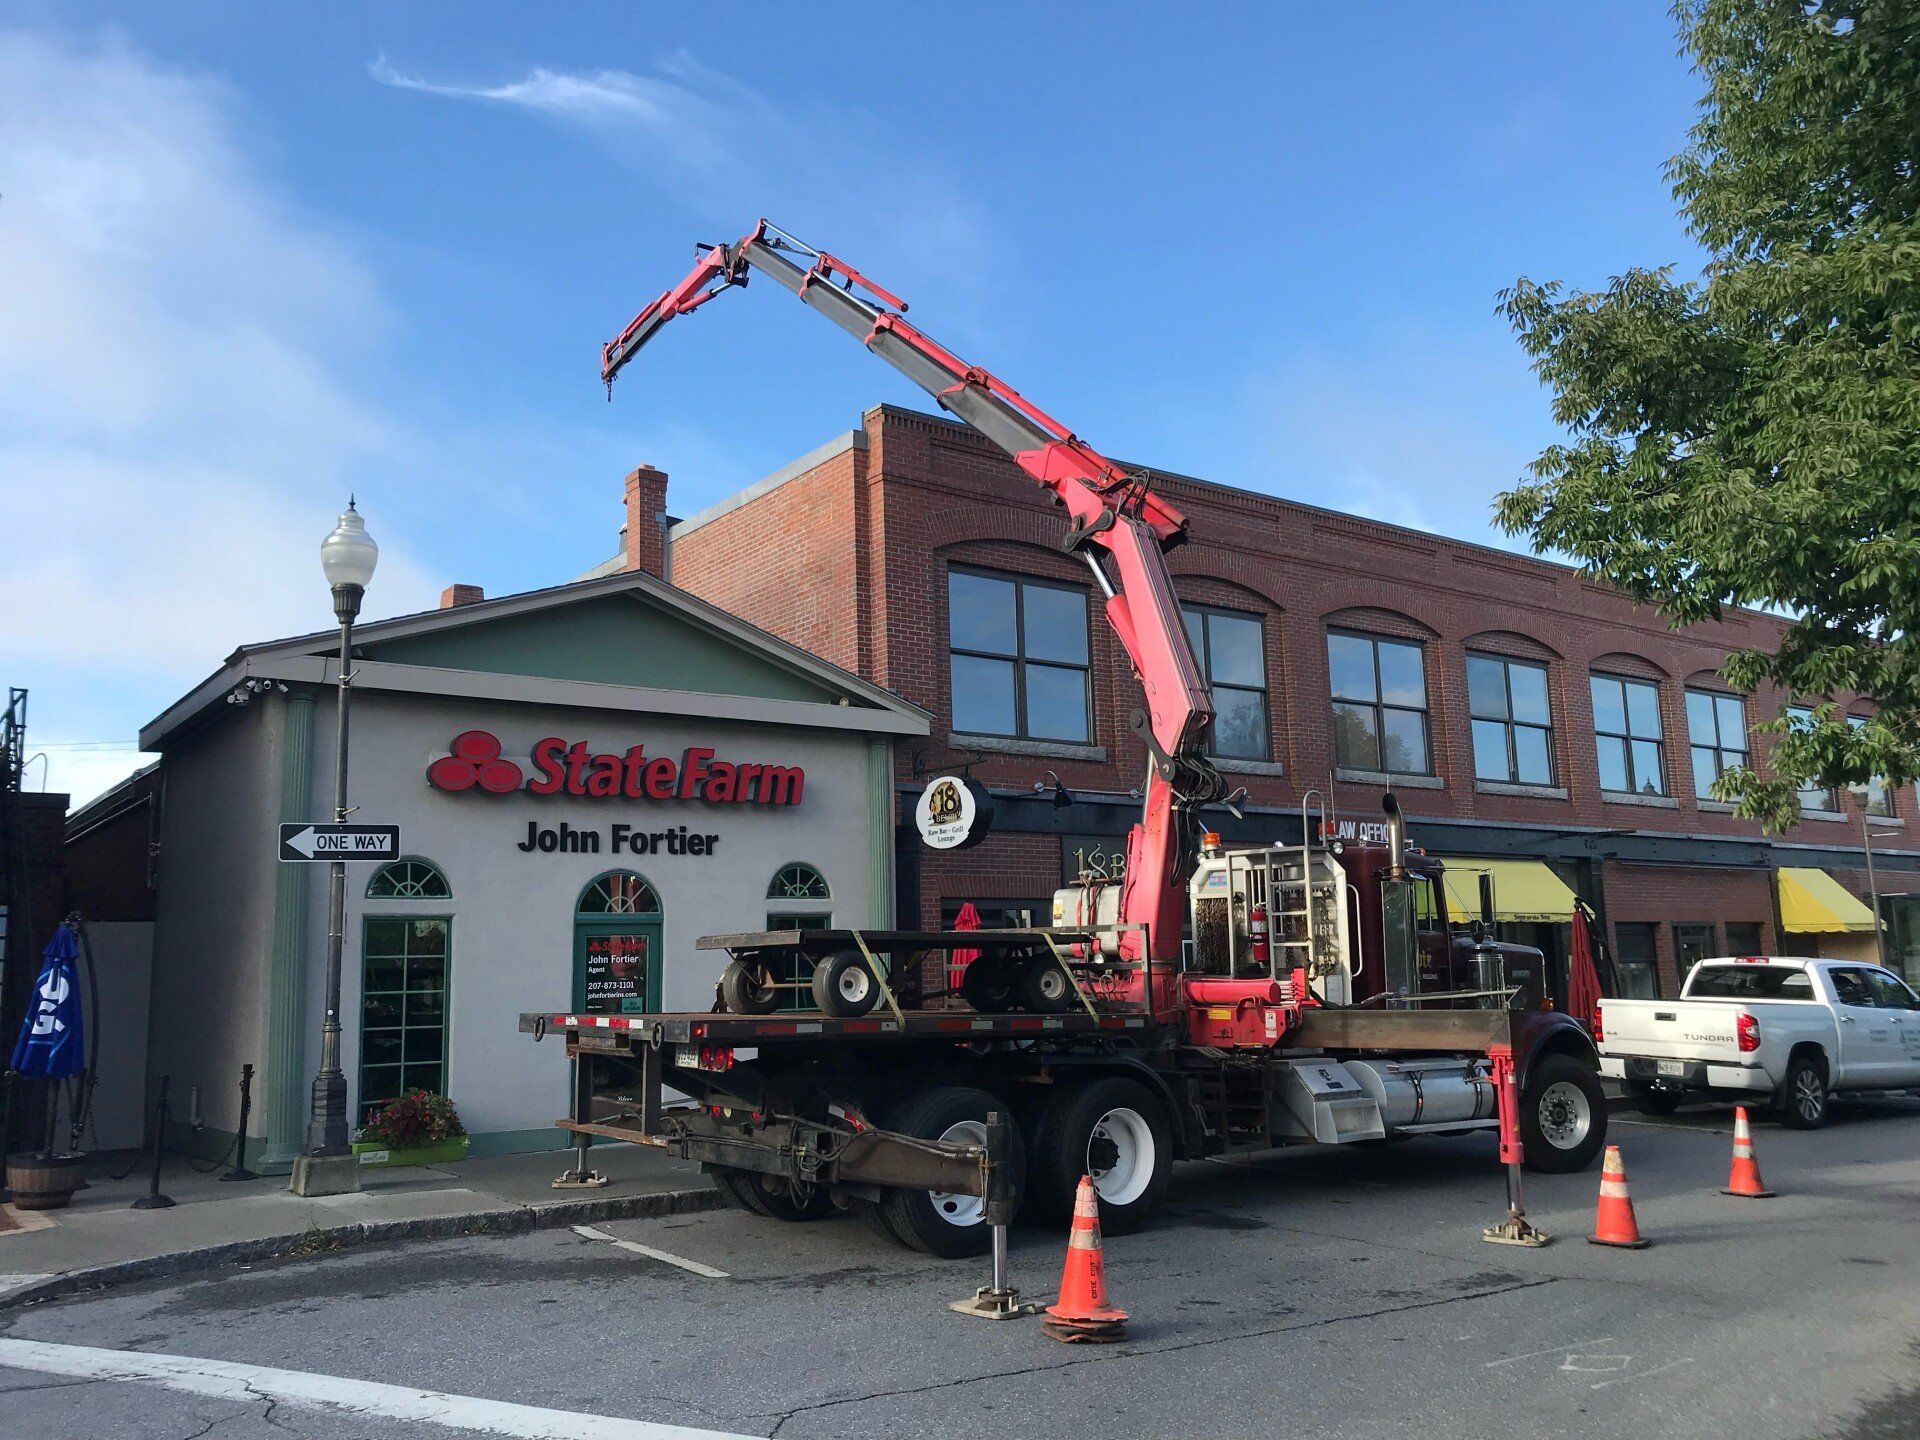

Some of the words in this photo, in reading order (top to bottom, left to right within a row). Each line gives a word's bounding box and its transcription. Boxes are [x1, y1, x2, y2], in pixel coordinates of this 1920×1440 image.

[937, 781, 957, 813] 18
[316, 835, 349, 850] ONE
[354, 835, 387, 850] WAY
[517, 821, 599, 853] John
[611, 824, 719, 856] Fortier
[937, 835, 956, 843] Lounge
[588, 955, 608, 964] John
[611, 954, 638, 964] Fortier
[588, 981, 634, 990] 207-873-1101
[1683, 1033, 1734, 1043] TUNDRA
